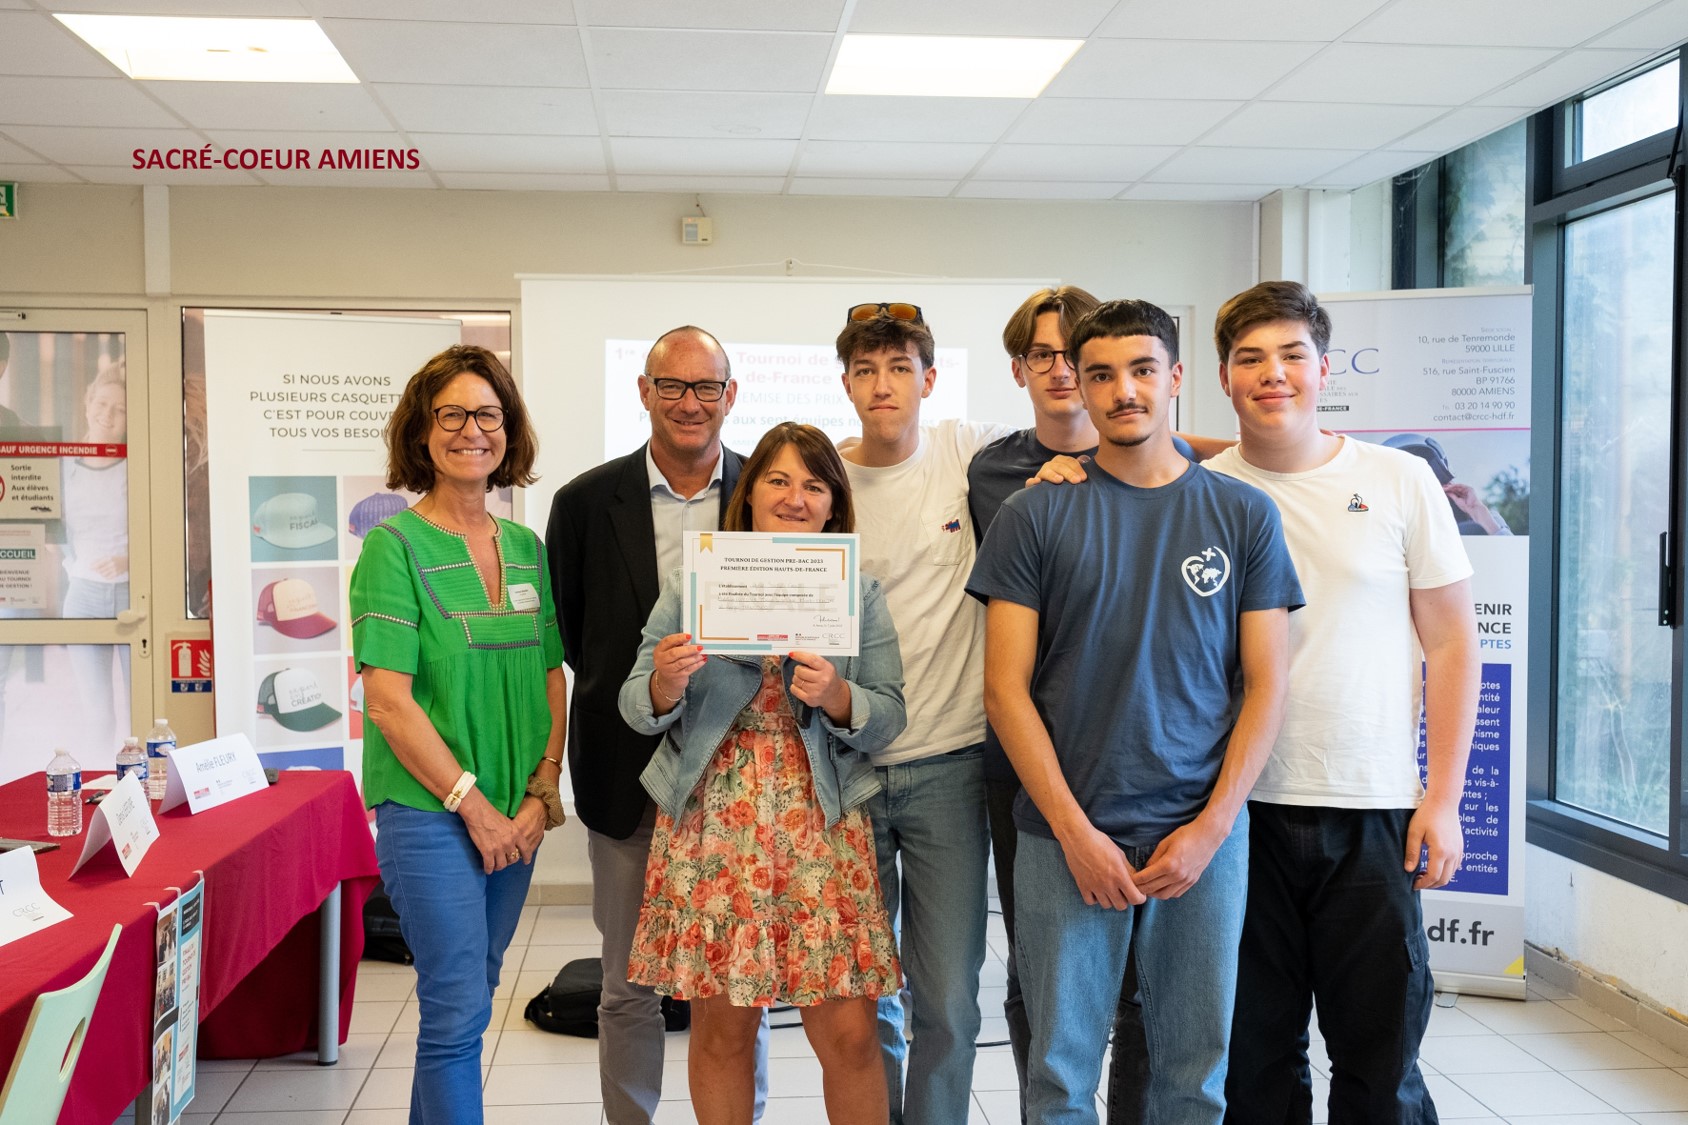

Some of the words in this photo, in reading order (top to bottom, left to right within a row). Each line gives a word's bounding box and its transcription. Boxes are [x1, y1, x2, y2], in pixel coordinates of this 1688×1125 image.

[1418, 336, 1430, 344] 10,
[1462, 334, 1516, 342] Tenremonde
[1465, 344, 1490, 352] 59000
[1492, 344, 1515, 352] LILLE
[736, 352, 801, 365] Tournoi
[808, 354, 829, 366] de
[1327, 348, 1380, 376] CC
[1422, 368, 1440, 376] 516,
[1458, 366, 1516, 374] Saint-Fuscien
[282, 374, 295, 384] SI
[300, 374, 340, 385] NOUS
[344, 376, 391, 386] AVONS
[746, 371, 833, 384] de-France
[1476, 376, 1488, 384] BP
[1490, 376, 1516, 384] 91766
[1452, 388, 1476, 396] 80000
[1478, 387, 1516, 395] AMIENS
[250, 392, 327, 402] PLUSIEURS
[331, 393, 403, 405] CASQUETT
[787, 392, 810, 404] DES
[816, 393, 844, 405] PRIX
[1454, 402, 1465, 410] 03
[1468, 402, 1478, 410] 20
[1480, 402, 1490, 410] 14
[1492, 402, 1502, 410] 90
[1504, 402, 1516, 410] 90
[264, 410, 301, 420] C'EST
[306, 410, 345, 420] POUR
[732, 416, 756, 424] aux
[270, 428, 307, 438] TOUS
[311, 428, 340, 438] VOS
[344, 428, 385, 438] BESOI
[0, 446, 16, 454] AUF
[18, 446, 57, 454] URGENCE
[60, 446, 98, 454] INCENDIE
[0, 550, 36, 558] CCUEIL
[1474, 603, 1512, 615] ENIR
[1478, 622, 1512, 634] NCE
[1480, 639, 1512, 649] PTES
[1480, 682, 1500, 691] ptes
[1479, 692, 1500, 702] ntité
[1478, 704, 1500, 714] aleur
[1476, 718, 1500, 726] ssent
[1474, 730, 1500, 738] nisme
[213, 752, 236, 766] FLEURY
[1472, 765, 1484, 774] de
[1491, 766, 1499, 775] la
[1462, 790, 1482, 799] ntes
[1486, 802, 1498, 812] les
[1458, 813, 1476, 822] bles
[1486, 814, 1498, 824] de
[1462, 826, 1498, 837] 'activité
[1460, 852, 1498, 863] pproche
[1466, 864, 1498, 874] entités
[1427, 918, 1494, 946] df.fr
